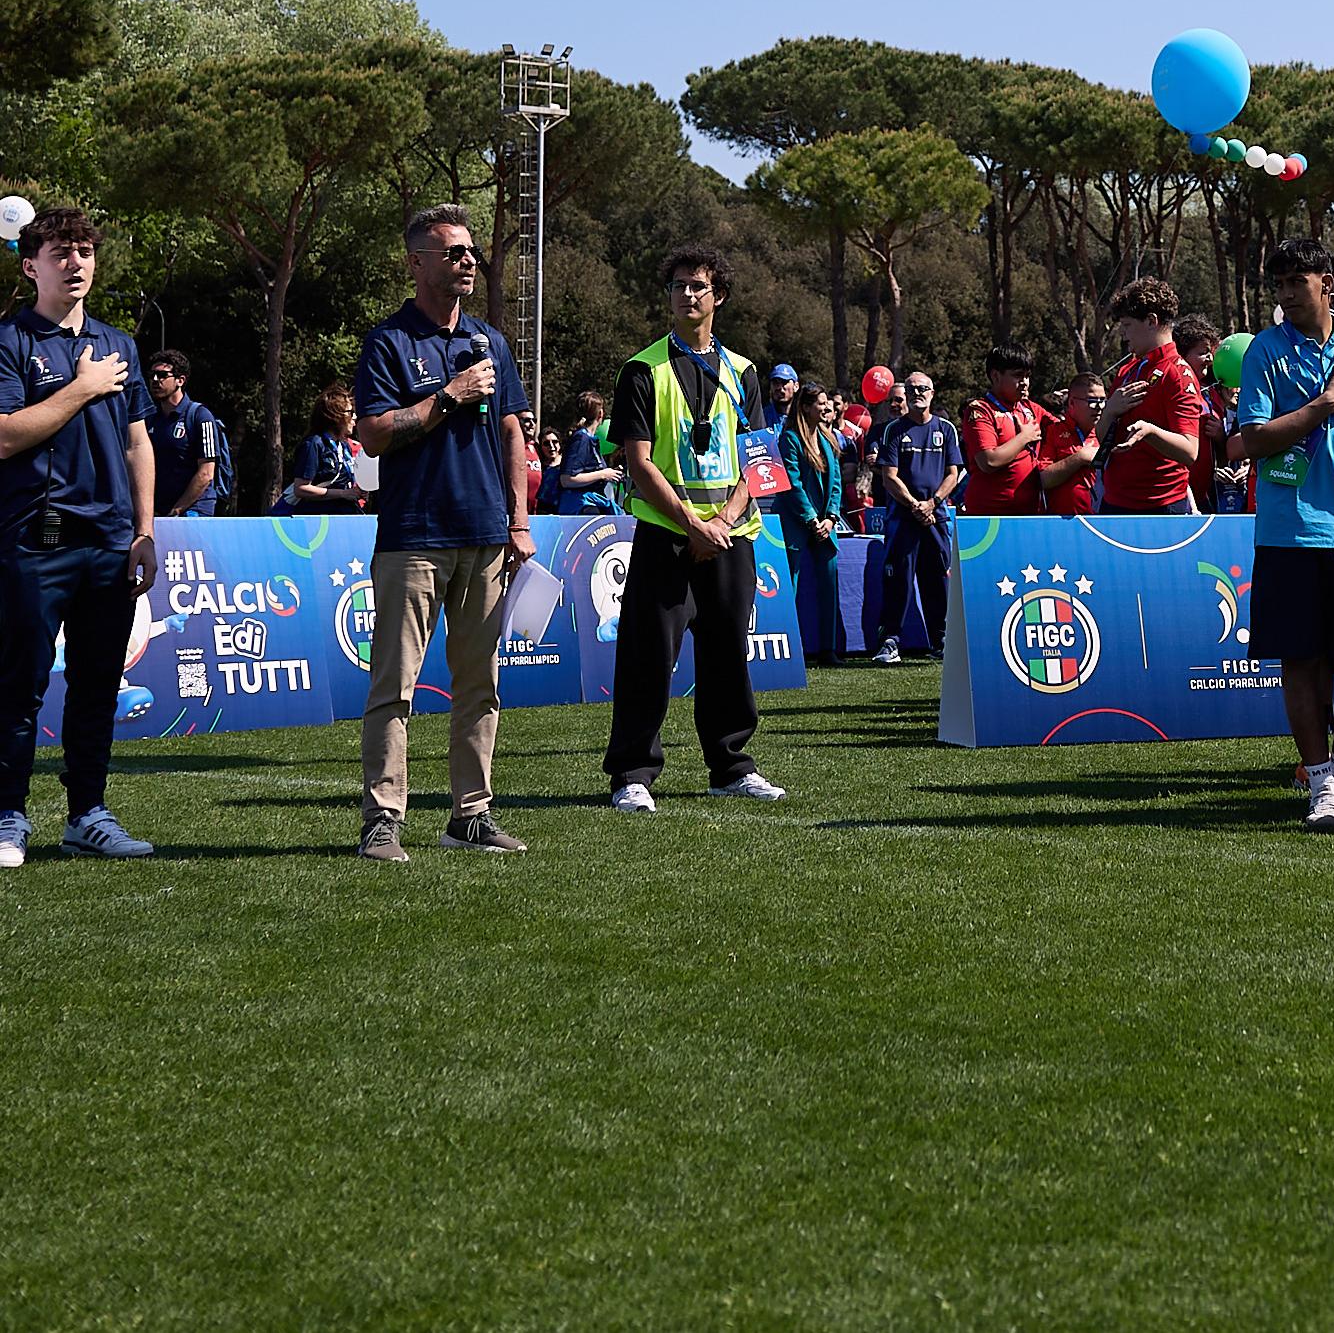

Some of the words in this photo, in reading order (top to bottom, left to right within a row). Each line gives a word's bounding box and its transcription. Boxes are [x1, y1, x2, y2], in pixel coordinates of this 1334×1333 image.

[1269, 469, 1297, 480] SQUADRA
[164, 550, 216, 581] #IL
[1024, 624, 1075, 648] FIGC
[505, 640, 534, 653] FIGC
[1042, 649, 1062, 657] ITALIA
[510, 654, 560, 666] PARALIMPICO
[1222, 659, 1260, 674] FIGC
[218, 659, 311, 694] TUTTI
[1190, 678, 1226, 690] CALCIO
[1228, 676, 1282, 689] PARALIMPI
